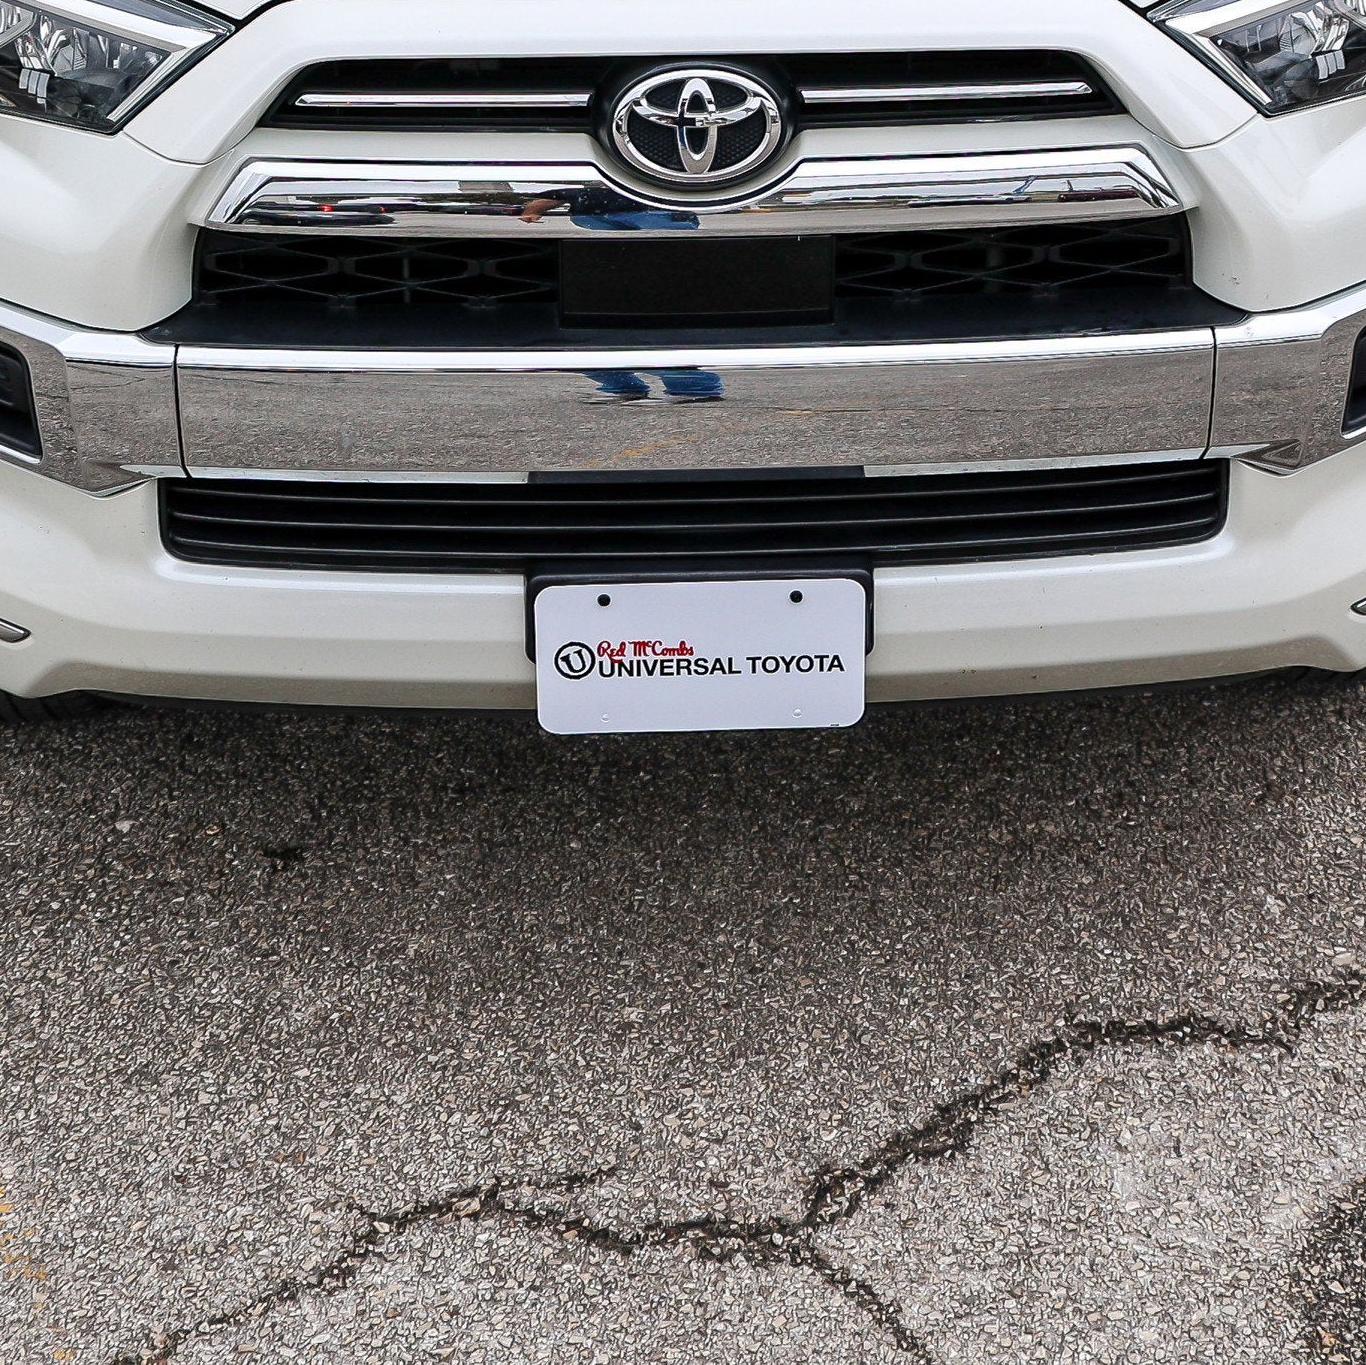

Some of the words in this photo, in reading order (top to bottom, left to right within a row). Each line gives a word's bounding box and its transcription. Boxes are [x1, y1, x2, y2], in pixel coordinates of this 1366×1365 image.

[597, 640, 627, 663] Red
[599, 657, 742, 678] UNIVERSAL
[746, 654, 845, 674] TOYOTA
